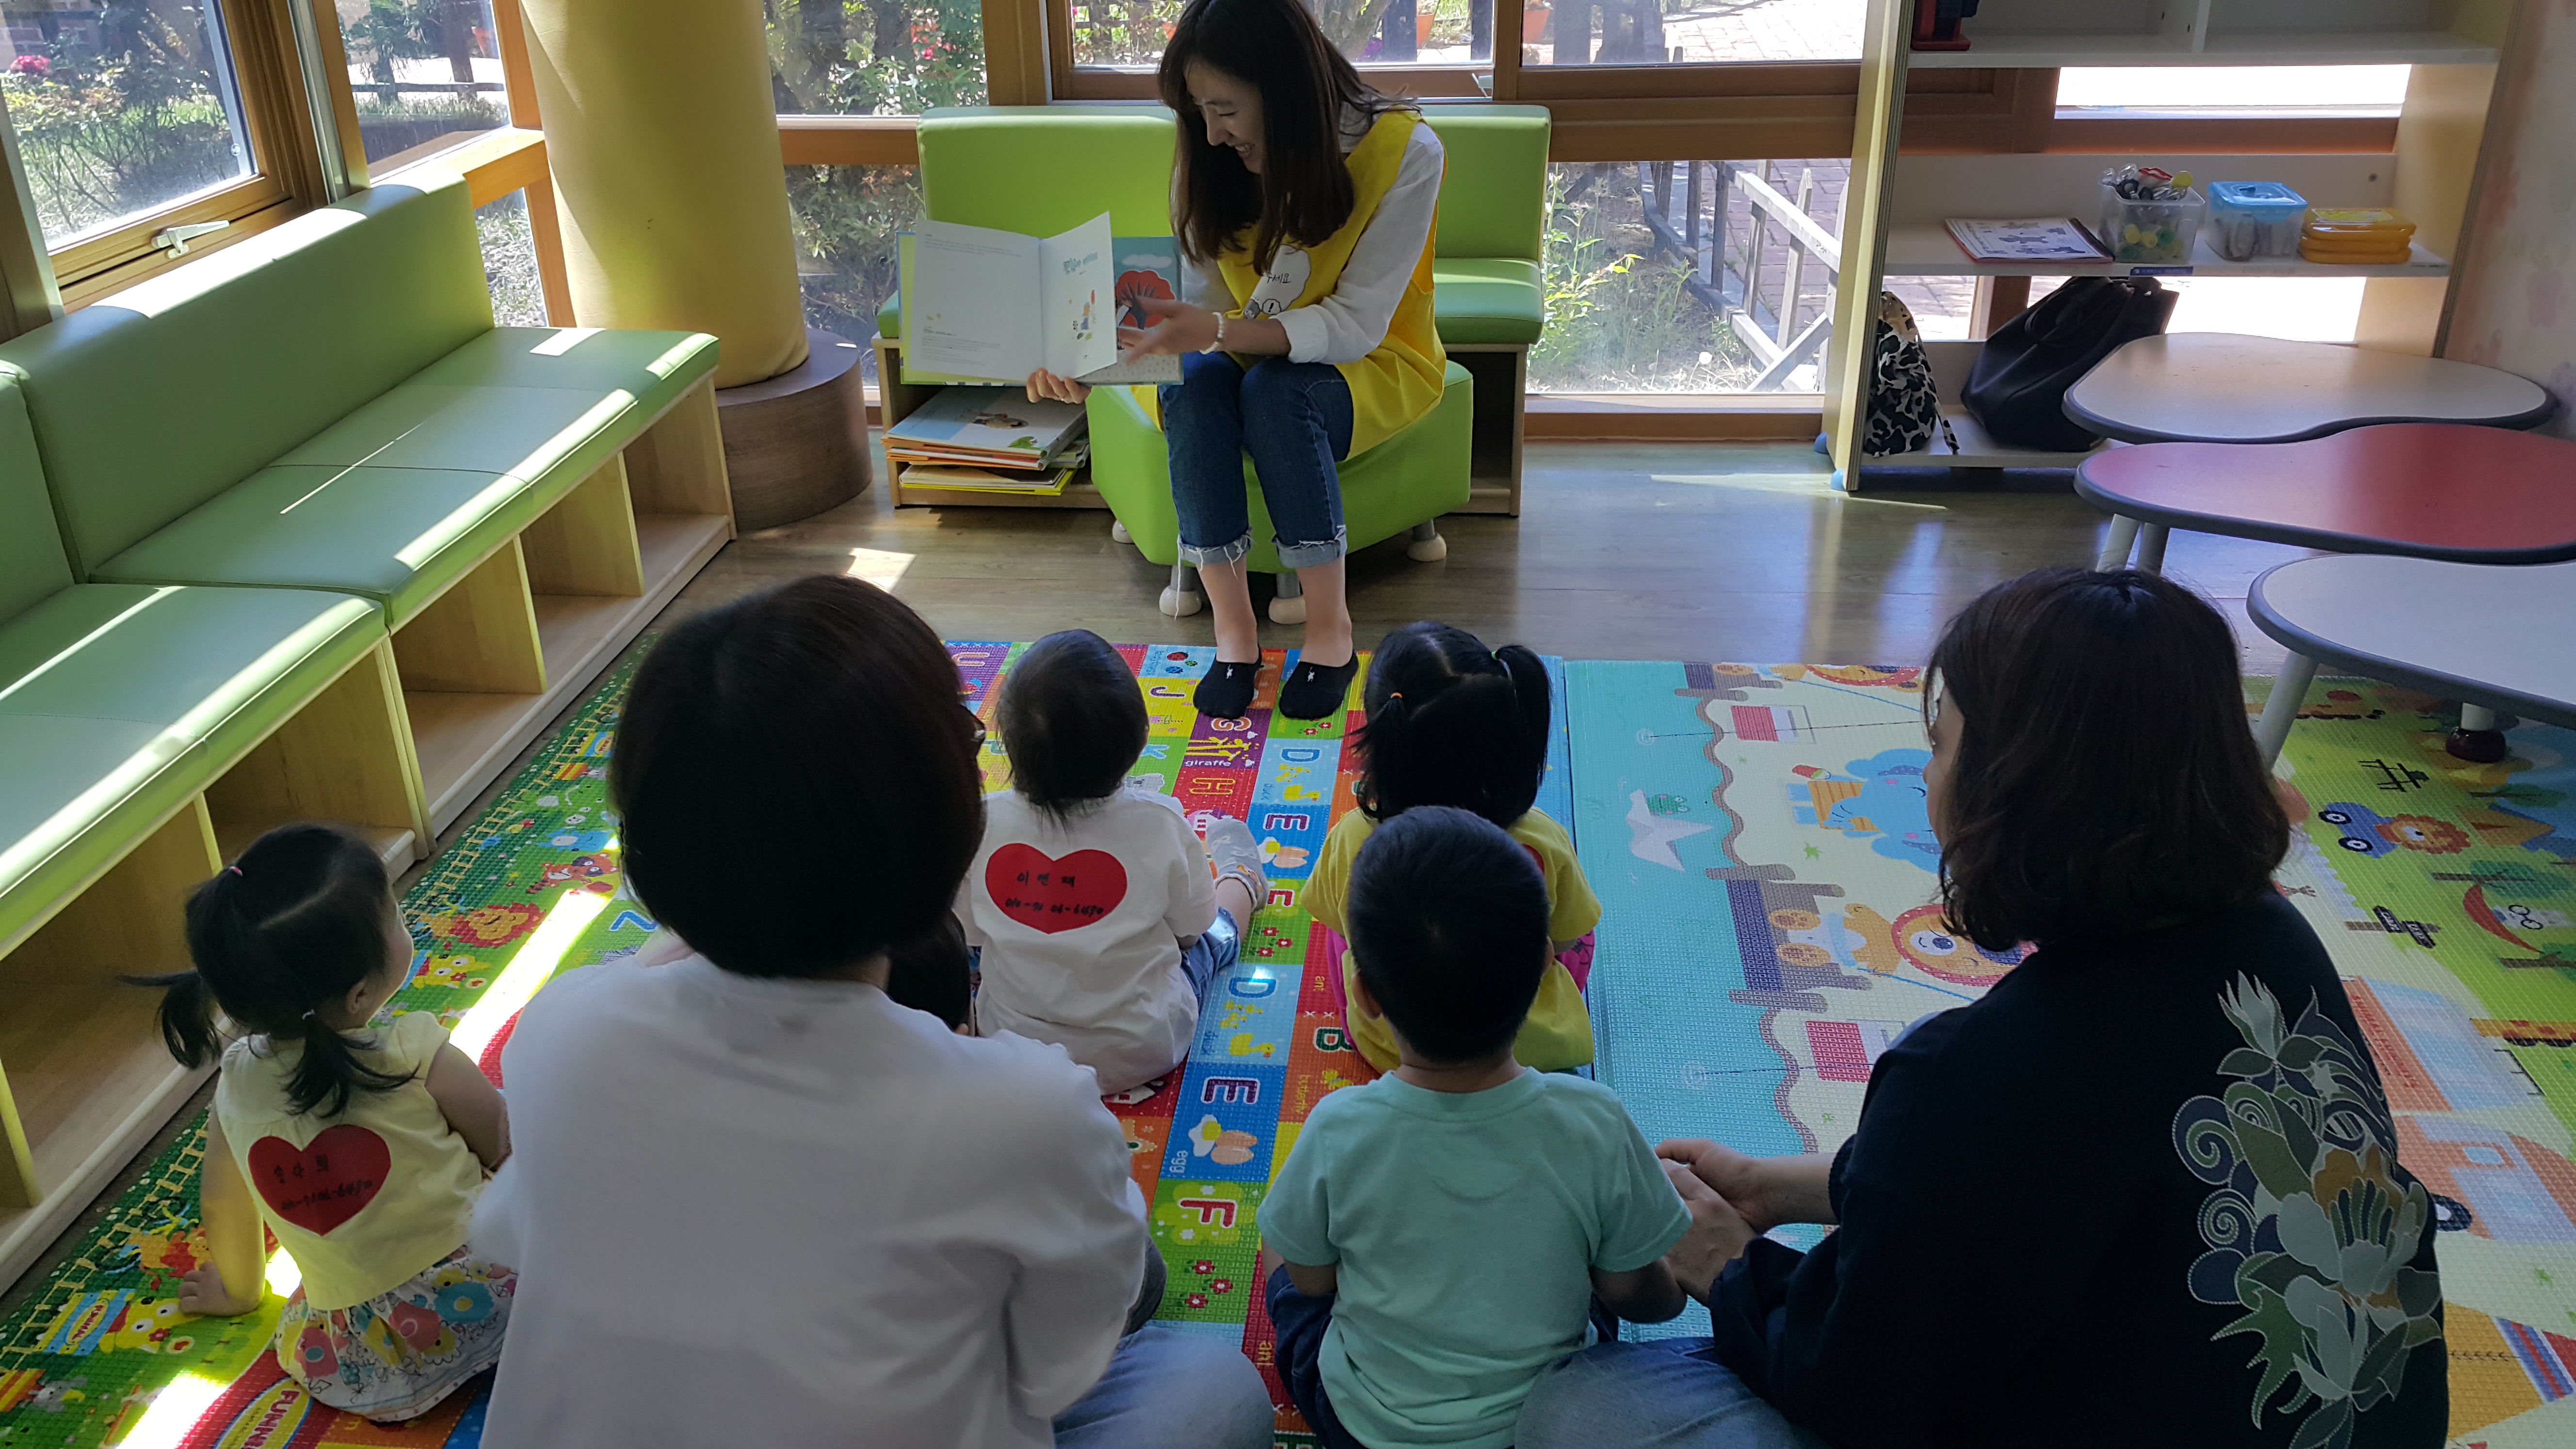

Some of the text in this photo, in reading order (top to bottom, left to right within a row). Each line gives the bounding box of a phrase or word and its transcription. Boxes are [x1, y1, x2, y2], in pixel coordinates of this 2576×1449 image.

[1149, 686, 1186, 698] J
[1211, 716, 1252, 731] G
[1280, 748, 1321, 762] D
[1190, 778, 1236, 794] H
[1263, 813, 1310, 831] E
[1229, 977, 1276, 998] D
[1313, 975, 1325, 991] ant
[1201, 1076, 1260, 1104] E
[1169, 1150, 1189, 1174] egg
[1177, 1198, 1237, 1228] F
[1256, 1341, 1274, 1368] ant
